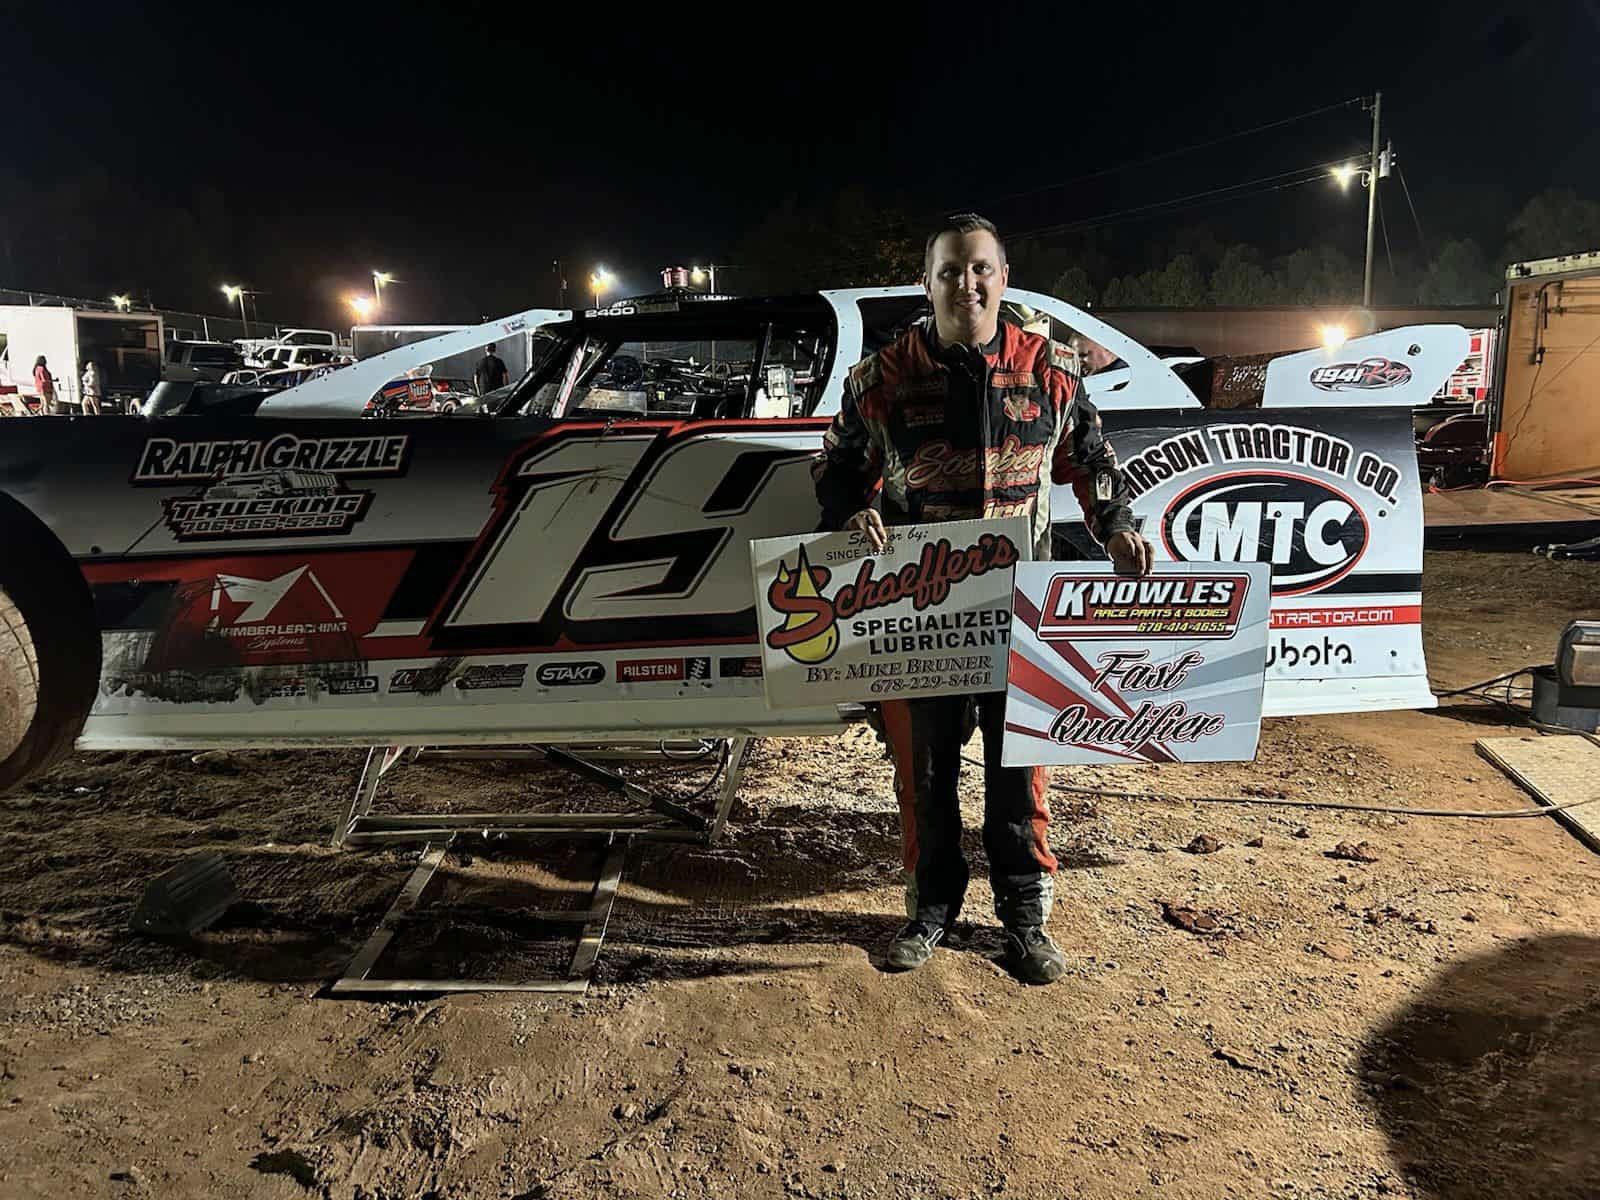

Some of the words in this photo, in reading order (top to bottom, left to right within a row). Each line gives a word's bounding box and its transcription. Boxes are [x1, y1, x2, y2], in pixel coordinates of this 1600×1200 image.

[585, 307, 635, 318] 2400
[1313, 367, 1361, 383] 1941
[139, 438, 258, 478] RALPH
[263, 434, 405, 471] GRIZZLE
[1212, 428, 1349, 476] TRACTOR
[1359, 456, 1400, 504] CO.
[172, 495, 365, 520] TRUCKING
[906, 527, 929, 542] by:
[1192, 501, 1355, 565] MTC
[825, 549, 863, 561] SINCE
[766, 534, 1019, 648] Schaeffer's
[1054, 580, 1234, 617] KNOWLES
[853, 609, 1010, 636] SPECIALIZED
[1093, 609, 1128, 618] RACE
[1130, 609, 1171, 618] PARTS
[1174, 609, 1182, 617] &
[1185, 608, 1228, 617] BODIES
[1265, 636, 1352, 668] ubota
[541, 666, 599, 681] STAKT
[805, 667, 841, 683] BY:
[846, 660, 902, 680] MIKE
[871, 672, 992, 693] 678-229-8461
[1091, 648, 1205, 693] Fast
[331, 678, 376, 690] WELD
[1047, 701, 1225, 757] Qualifier
